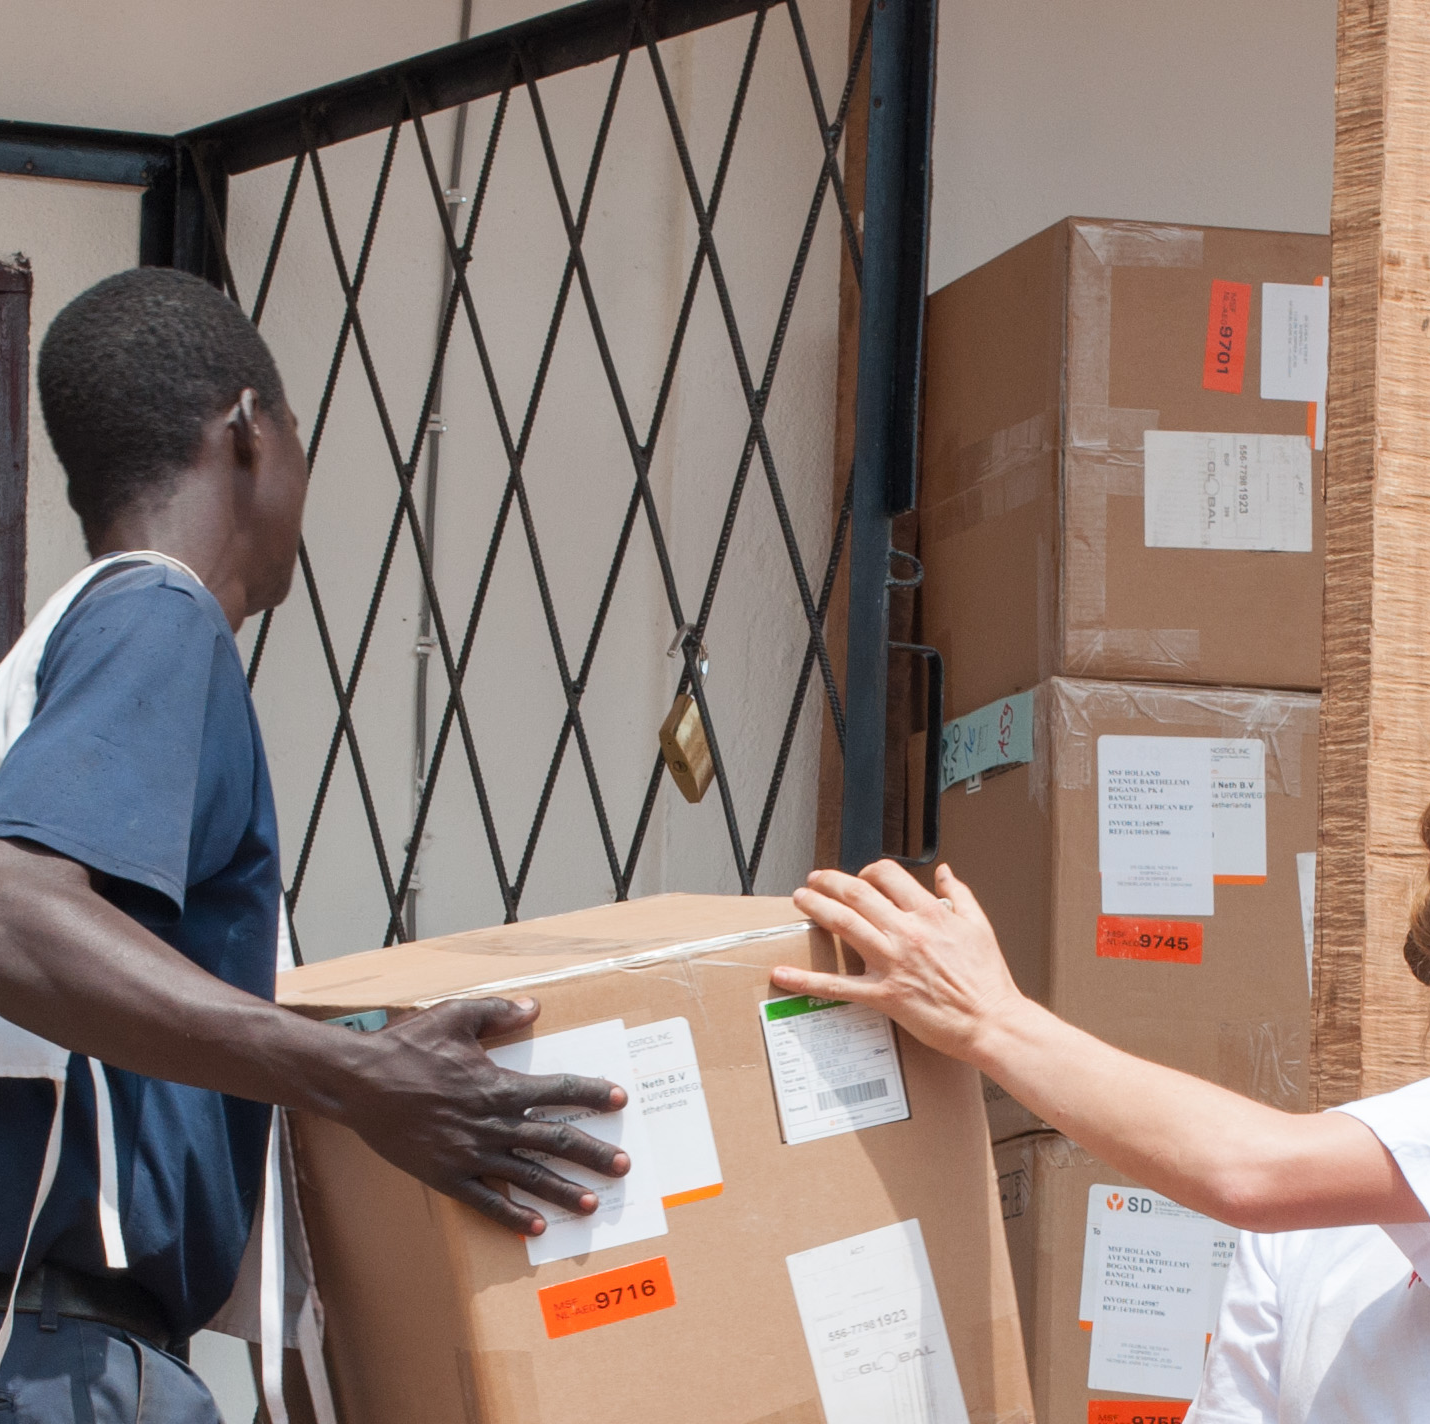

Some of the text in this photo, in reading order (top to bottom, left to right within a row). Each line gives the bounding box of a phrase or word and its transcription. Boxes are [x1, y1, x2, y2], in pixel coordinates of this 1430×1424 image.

[1216, 326, 1233, 375] 9701
[1139, 934, 1190, 952] 9745
[641, 1079, 666, 1090] Neth
[1127, 1196, 1153, 1215] SD
[1092, 1227, 1102, 1237] To
[1108, 1245, 1162, 1258] MSF HOLLAND
[1107, 1254, 1191, 1269] AVENUE BARTHELEMY
[1105, 1271, 1135, 1280] BANGUI
[1147, 1266, 1157, 1274] PK
[1104, 1279, 1192, 1295] CENTRAL AFRICAN REP
[595, 1279, 656, 1310] 9716
[553, 1298, 579, 1312] MSF
